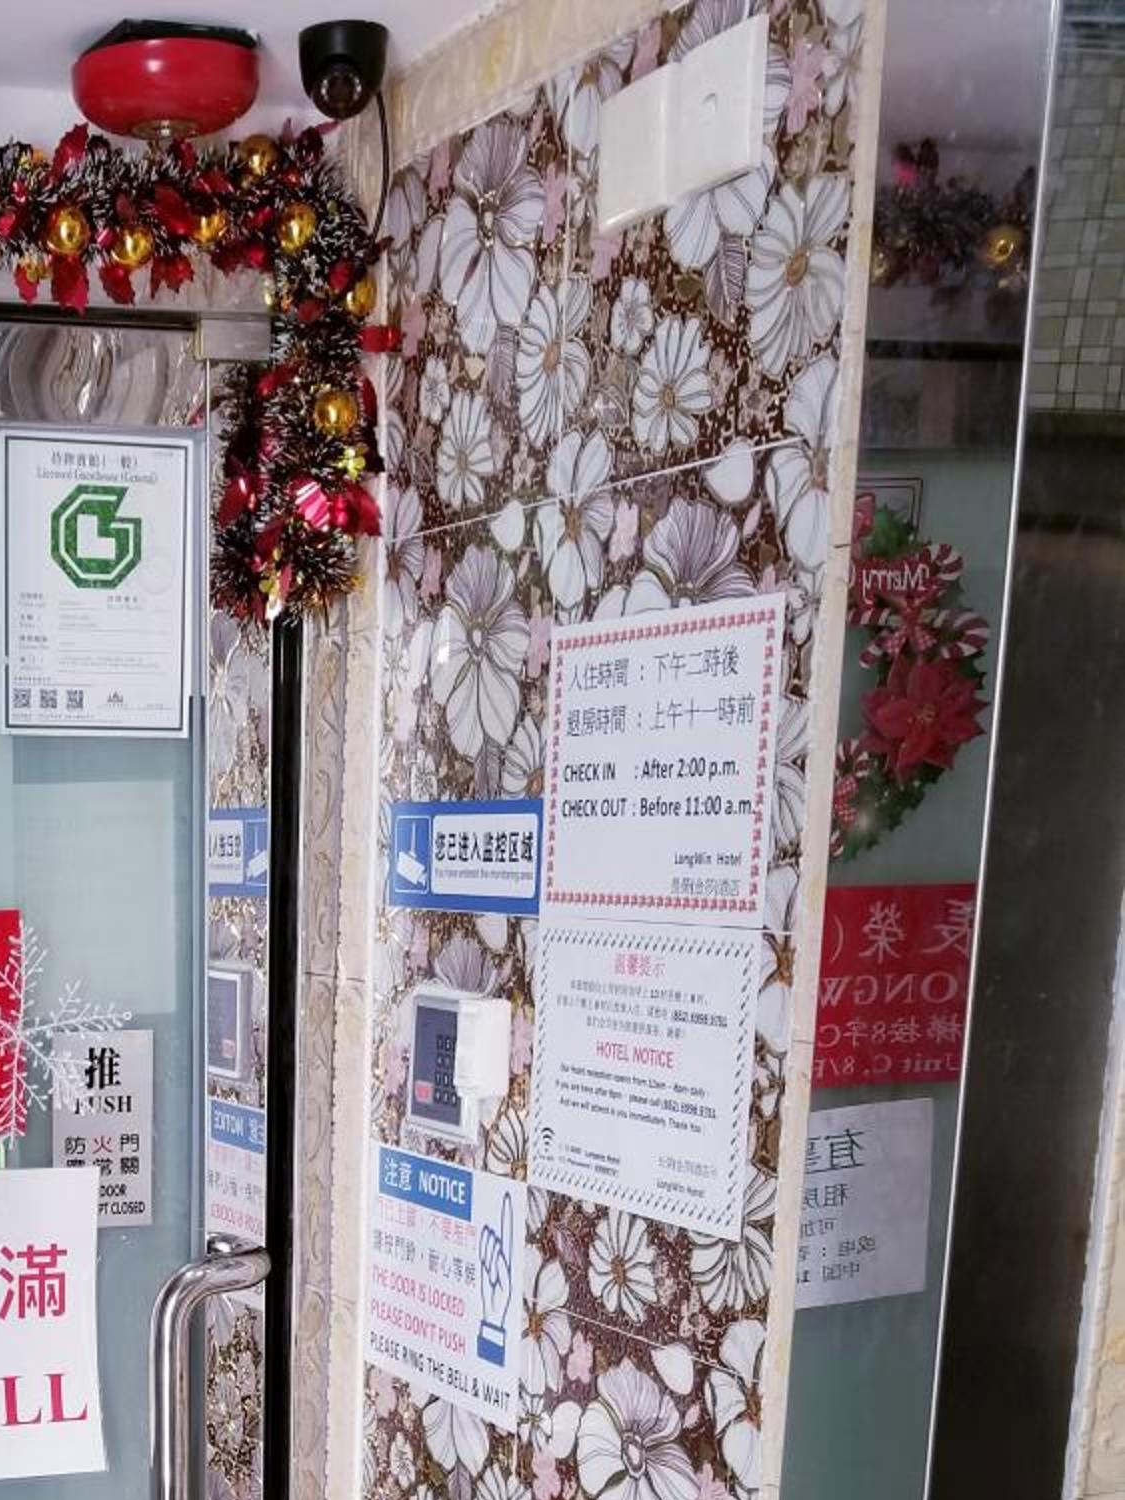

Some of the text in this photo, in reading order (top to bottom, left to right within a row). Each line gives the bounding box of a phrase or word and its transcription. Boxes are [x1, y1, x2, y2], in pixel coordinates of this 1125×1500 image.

[562, 763, 601, 784] CHECK
[601, 762, 617, 782] IN
[640, 759, 674, 780] After
[676, 756, 707, 779] 2:00
[708, 759, 741, 787] p.m.
[561, 799, 600, 819] CHECK
[600, 798, 627, 818] OUT
[639, 796, 681, 818] Before
[684, 795, 723, 817] 11:00
[724, 798, 757, 816] a.m.
[435, 831, 534, 863] 您已进入监控区域
[84, 1047, 122, 1090] 推
[595, 1039, 675, 1069] HOTEL NOTICE
[64, 1133, 141, 1156] 防火門
[383, 1157, 466, 1206] 注意 NOTICE
[110, 1201, 146, 1217] CLOSED
[372, 1263, 465, 1318] THE DOOR IS LOCKED
[371, 1299, 404, 1327] PLEASE
[438, 1325, 466, 1355] PUSH
[369, 1331, 401, 1362] PLEASE
[402, 1344, 424, 1373] RING
[426, 1357, 446, 1384] THE
[448, 1367, 469, 1393] BELL
[482, 1380, 511, 1412] WAIT
